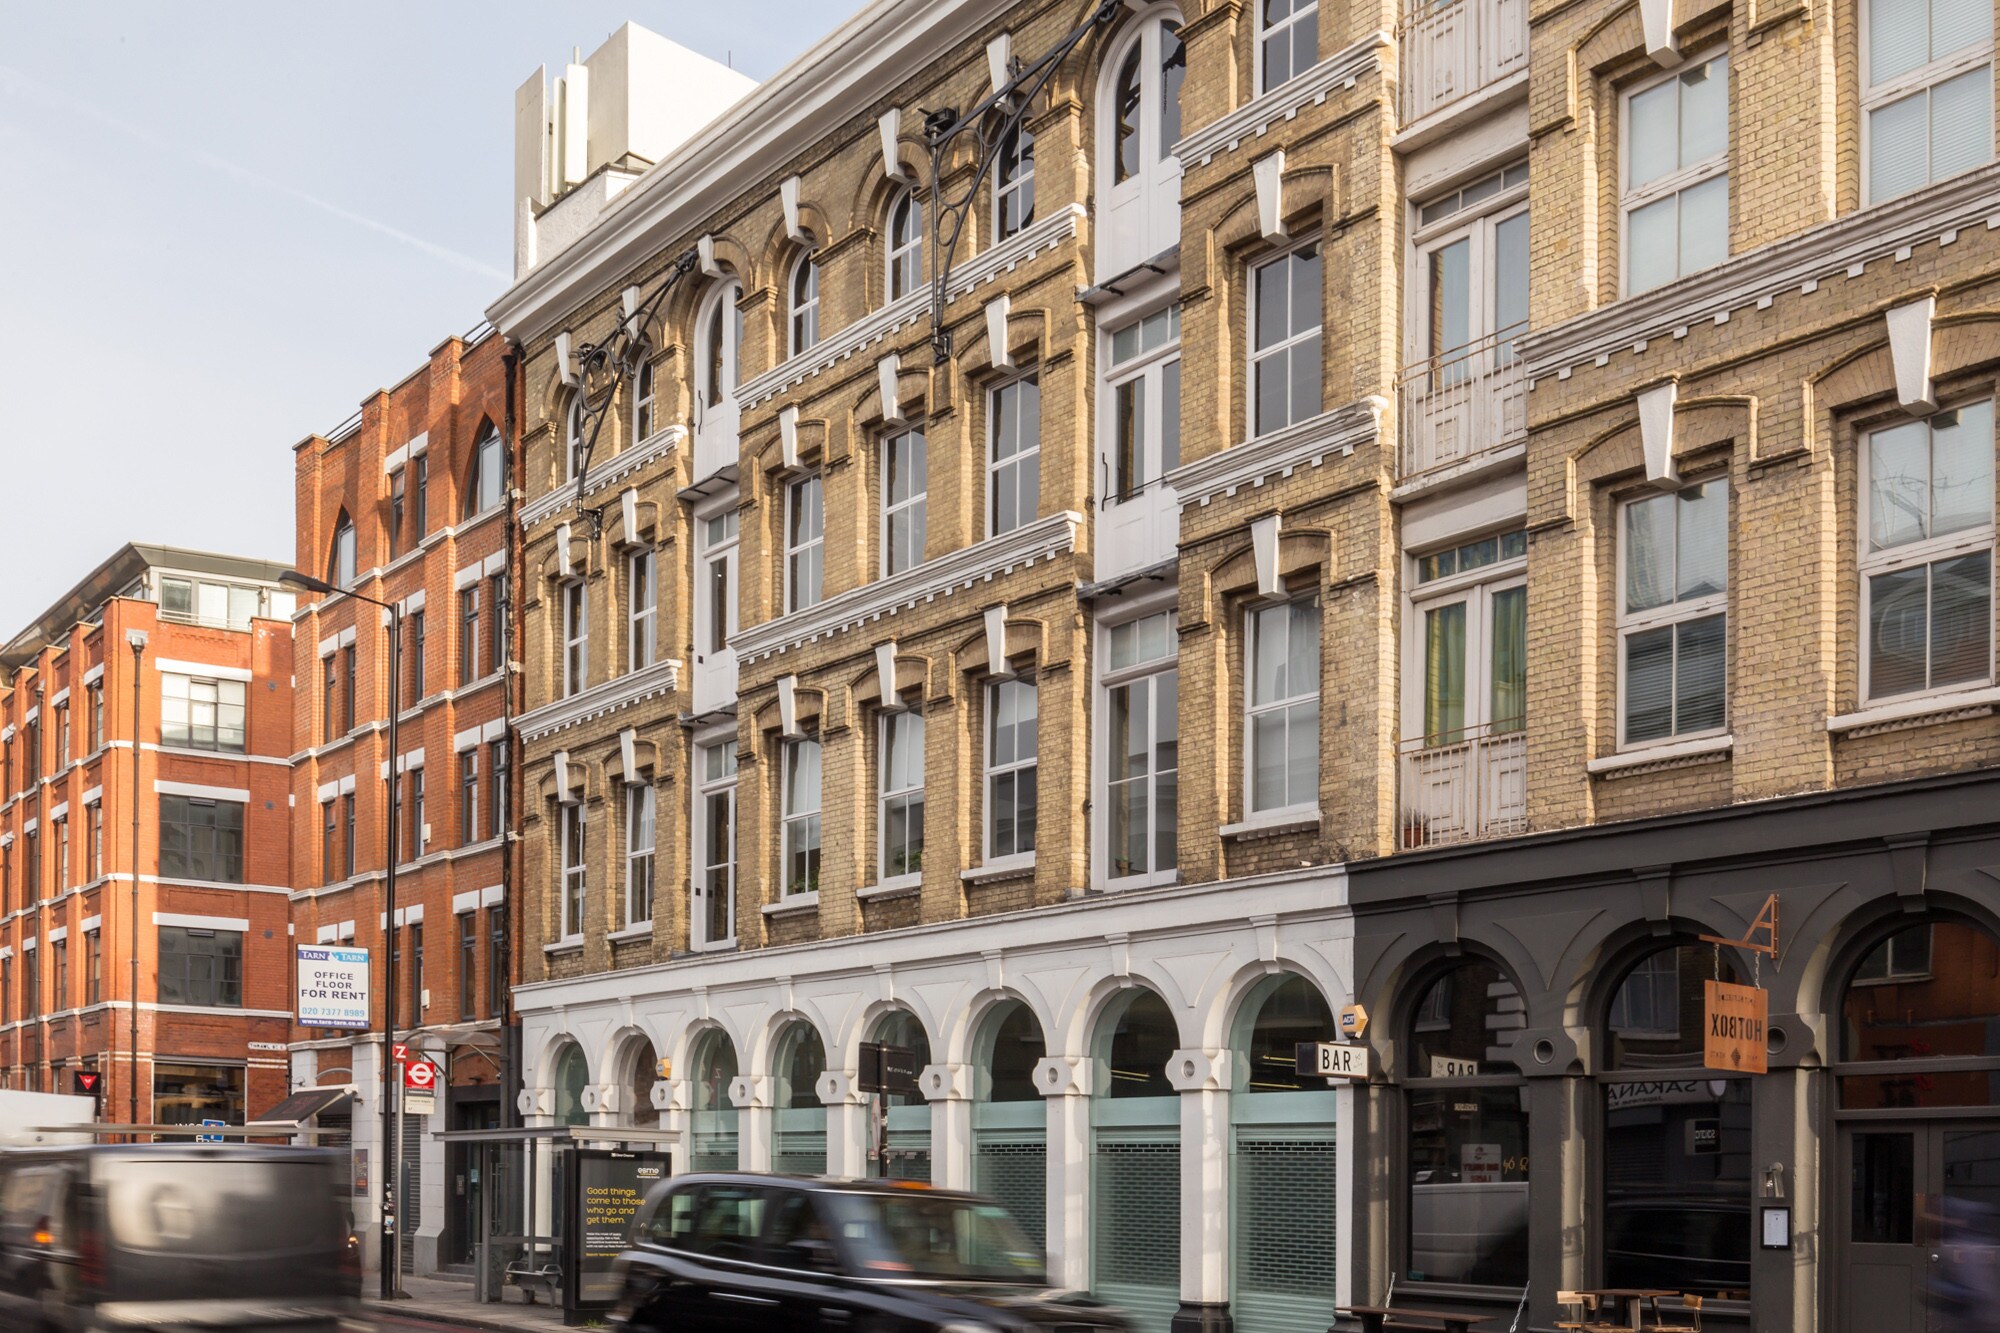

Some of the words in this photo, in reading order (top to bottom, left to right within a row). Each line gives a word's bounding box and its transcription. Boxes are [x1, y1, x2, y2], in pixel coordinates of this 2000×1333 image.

[301, 950, 326, 960] TARN
[341, 953, 365, 962] TARN
[314, 971, 354, 981] OFFICE
[316, 980, 353, 990] FLOOR
[301, 989, 327, 999] FOR
[331, 991, 366, 1001] RENT
[302, 1007, 318, 1016] 020
[321, 1008, 341, 1017] 7377
[343, 1009, 365, 1018] 8989
[301, 1019, 366, 1027] www.tarn-tarn.co.uk
[1342, 1015, 1354, 1024] ADT
[395, 1045, 407, 1059] Z
[1322, 1048, 1351, 1072] BAR
[587, 1187, 608, 1195] Good
[610, 1188, 636, 1197] things
[612, 1197, 621, 1205] to
[622, 1198, 646, 1206] those
[606, 1208, 617, 1216] go
[618, 1207, 635, 1215] and
[587, 1217, 600, 1225] get
[601, 1216, 625, 1224] them.
